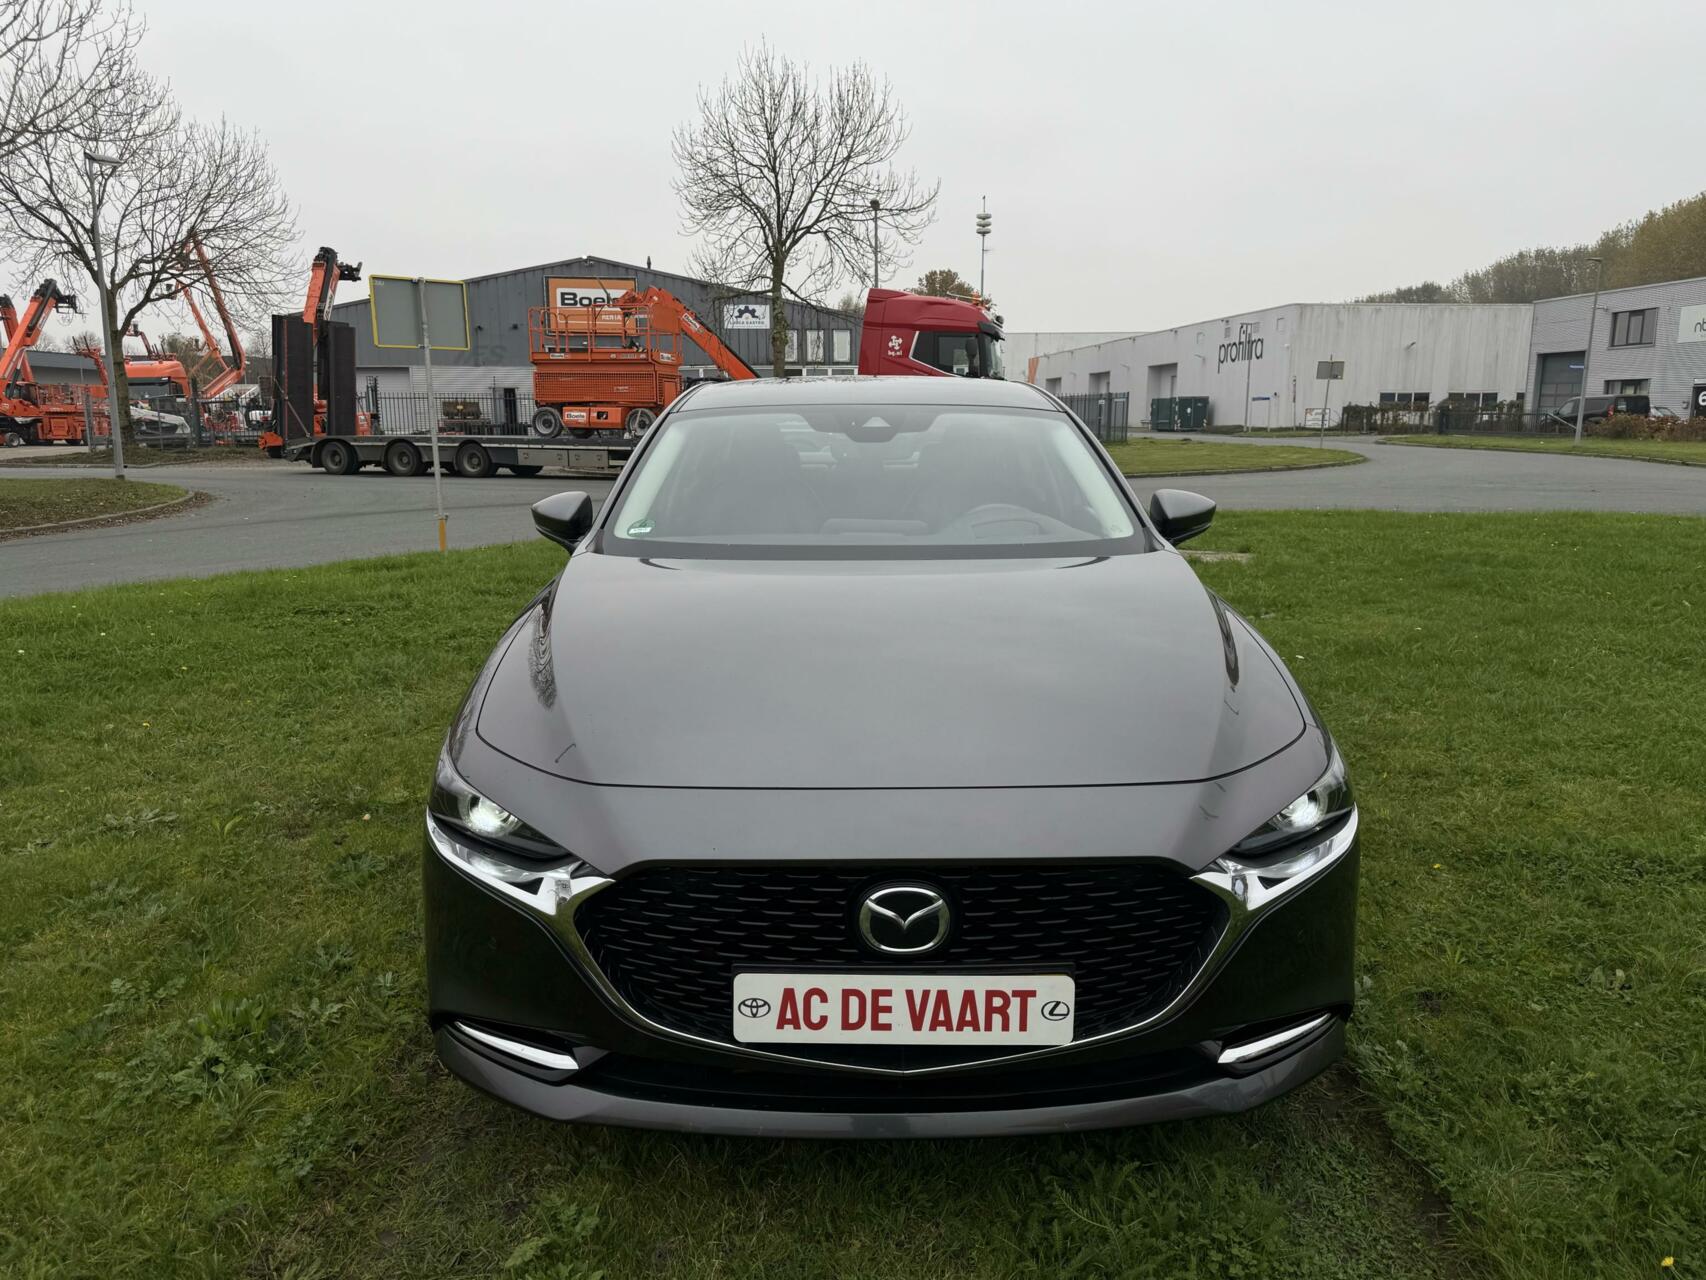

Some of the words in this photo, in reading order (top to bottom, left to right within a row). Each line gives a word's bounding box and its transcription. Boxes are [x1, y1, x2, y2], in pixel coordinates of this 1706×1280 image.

[1217, 324, 1264, 374] profiltra
[776, 987, 829, 1031] AC
[841, 988, 893, 1031] DE
[904, 988, 1037, 1032] VAART
